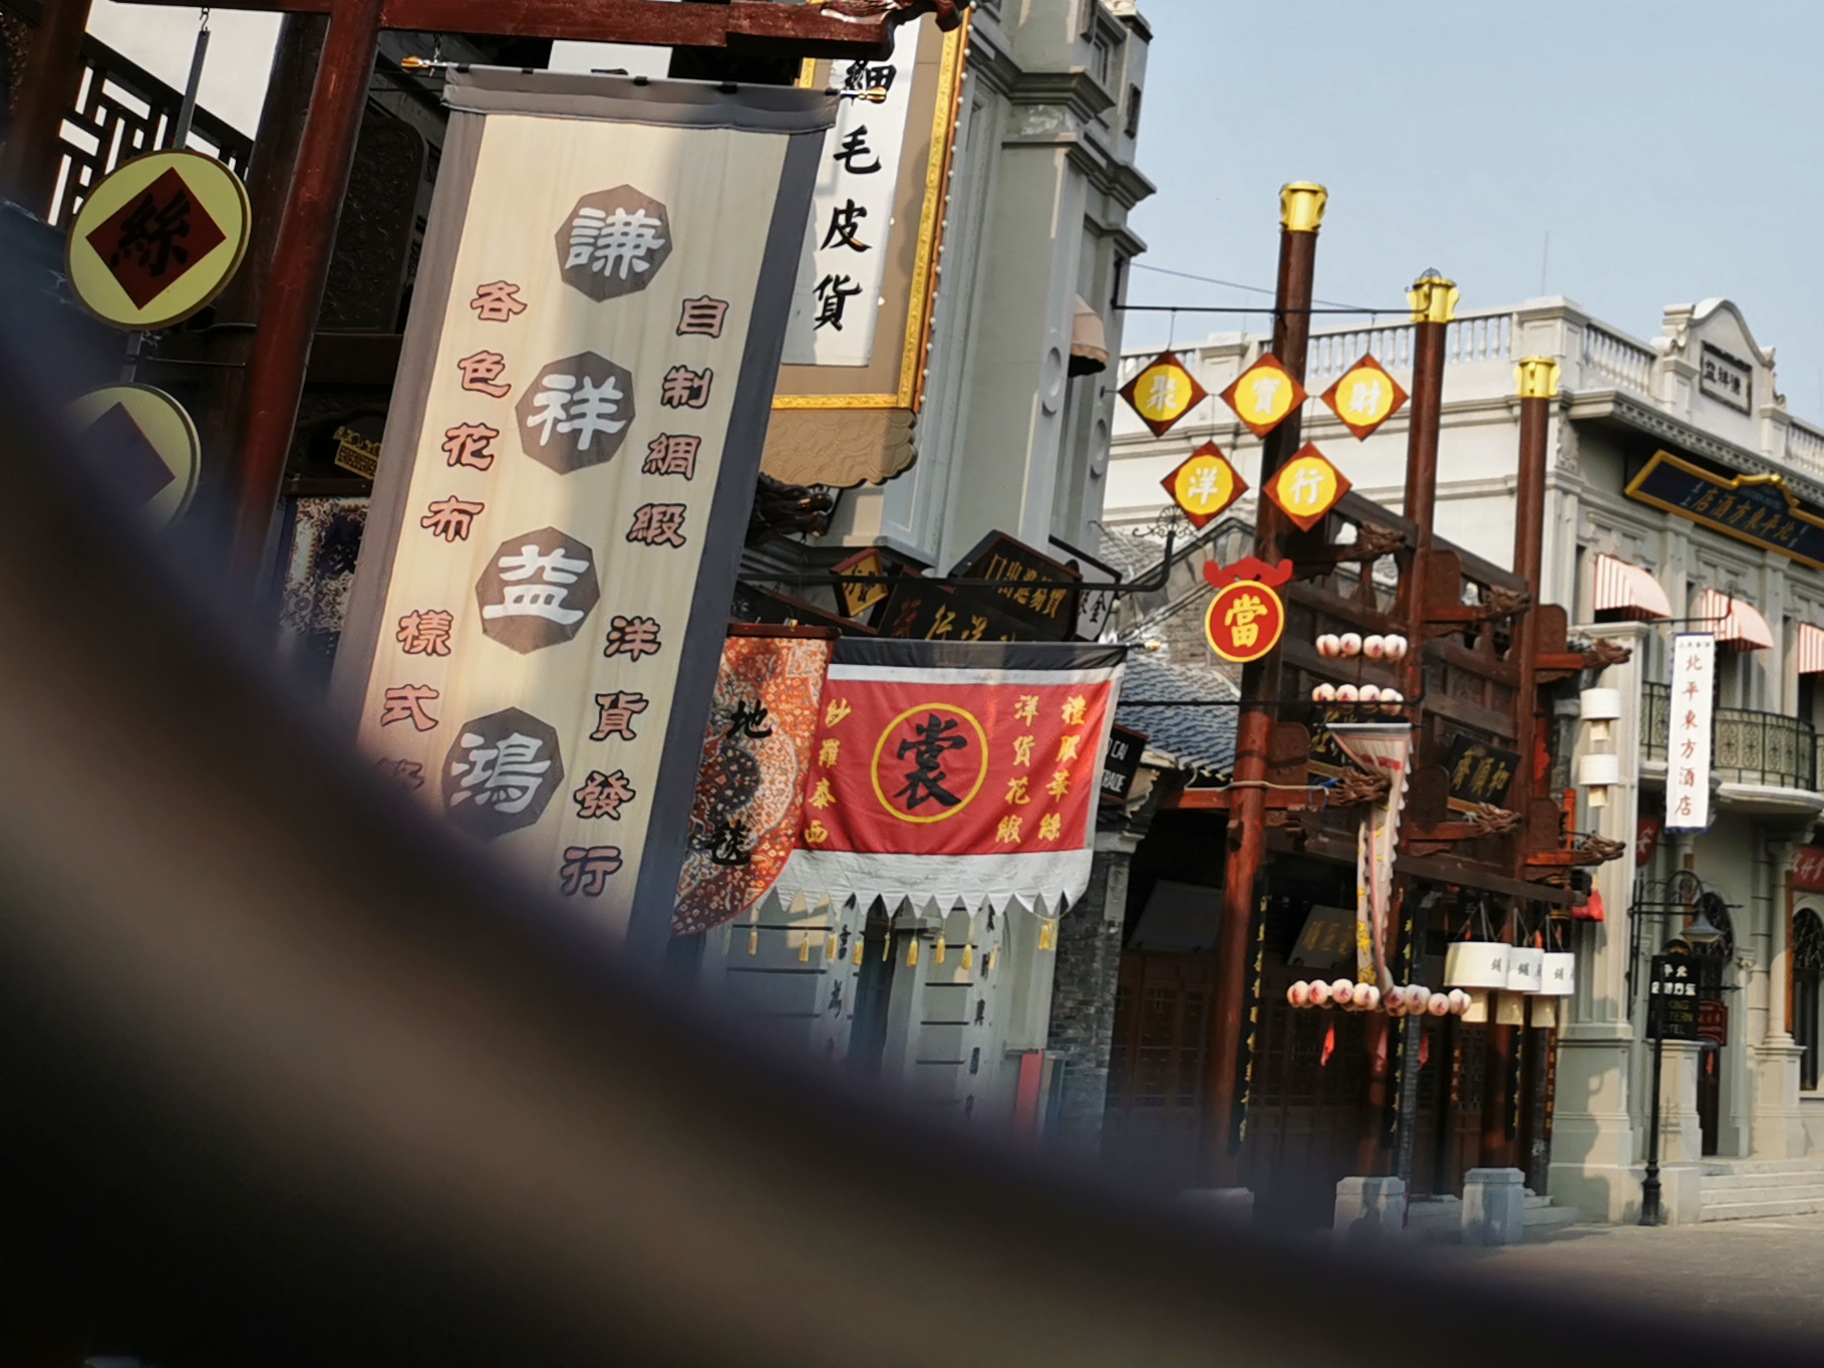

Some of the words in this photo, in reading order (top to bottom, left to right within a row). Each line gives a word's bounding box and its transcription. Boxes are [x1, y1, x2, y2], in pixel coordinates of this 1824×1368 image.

[1188, 466, 1324, 506] 洋行
[1223, 593, 1269, 649] 當
[894, 713, 968, 810] 裳
[1673, 654, 1704, 817] 北平東方酒店
